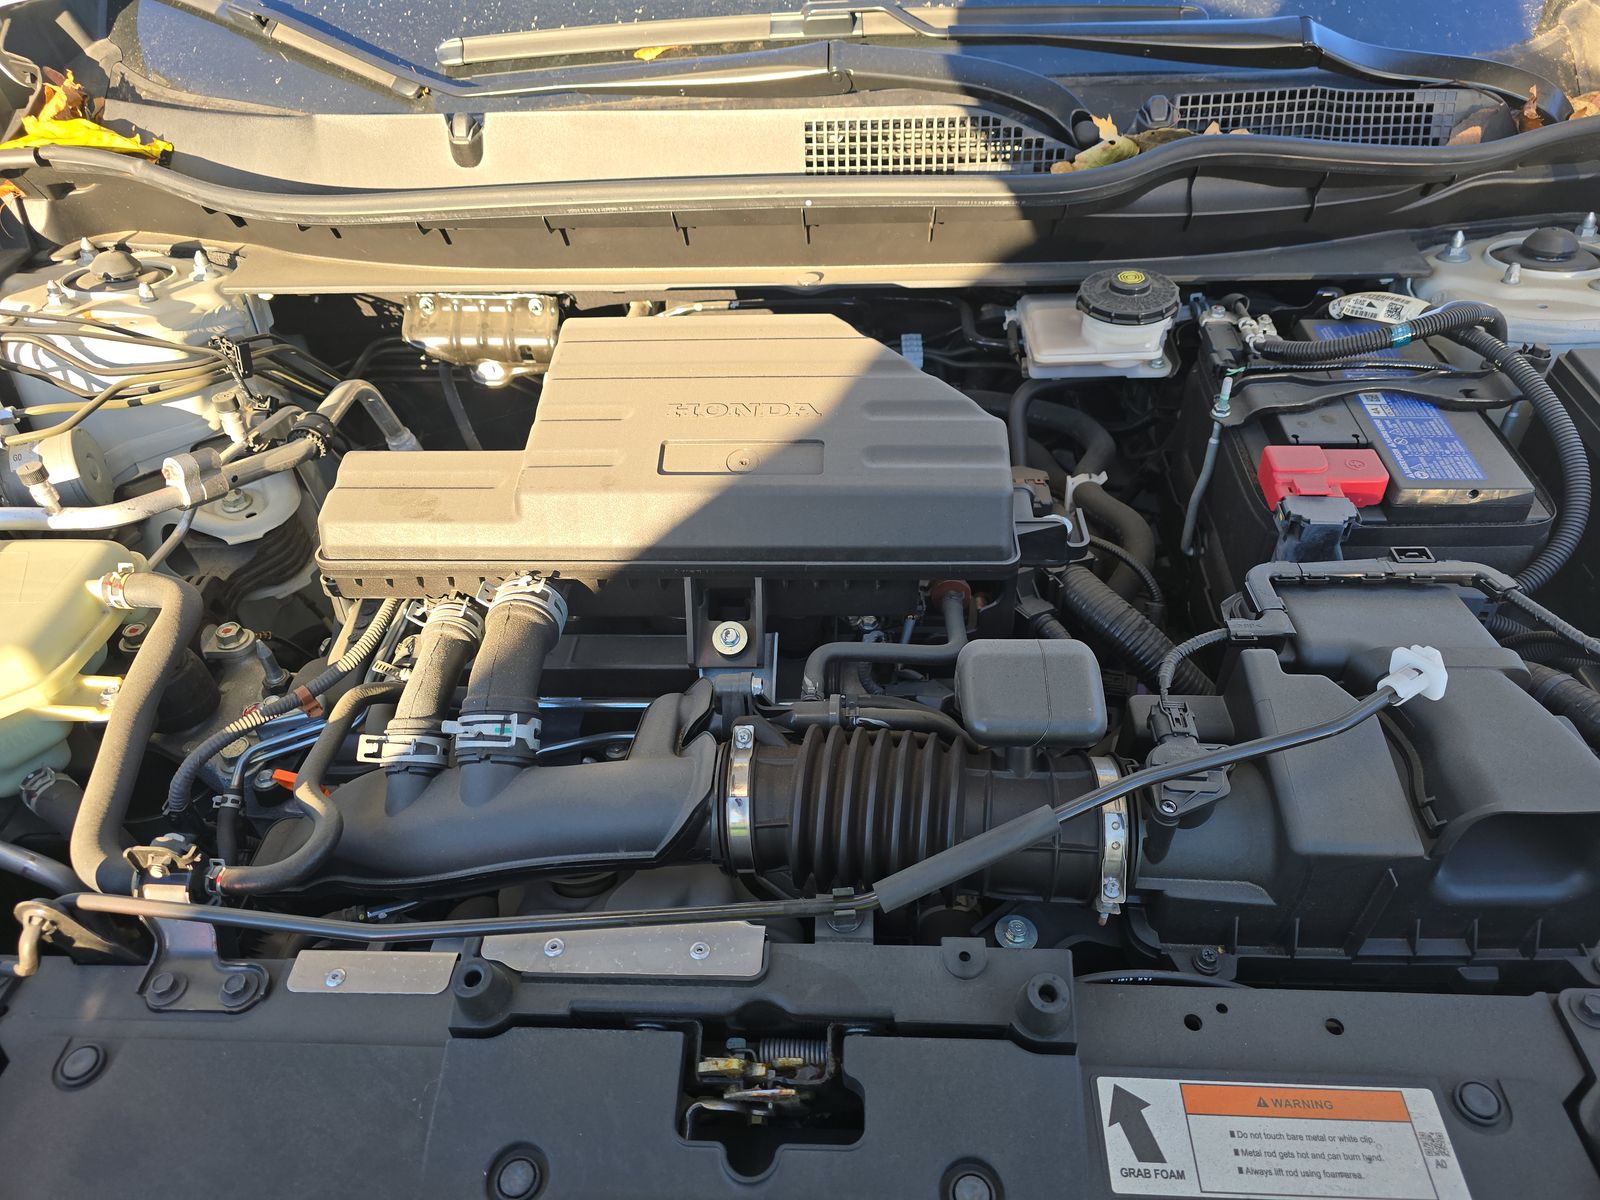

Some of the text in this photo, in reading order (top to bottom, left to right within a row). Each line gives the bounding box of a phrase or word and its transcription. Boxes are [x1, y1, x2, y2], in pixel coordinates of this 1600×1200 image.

[666, 402, 823, 418] HONDA
[1271, 1098, 1334, 1110] WARNING
[1236, 1130, 1248, 1139] Do
[1263, 1132, 1285, 1140] touch
[1286, 1133, 1304, 1141] bare
[1305, 1134, 1326, 1142] metal
[1338, 1133, 1358, 1143] white
[1360, 1135, 1376, 1145] clip.
[1240, 1148, 1262, 1157] Metal
[1264, 1150, 1277, 1158] rod
[1278, 1151, 1295, 1159] gets
[1296, 1151, 1310, 1159] hot
[1311, 1152, 1326, 1160] and
[1327, 1153, 1341, 1161] can
[1343, 1152, 1360, 1161] burn
[1120, 1167, 1186, 1180] GRAB FOAM
[1245, 1167, 1273, 1178] Always
[1274, 1168, 1284, 1177] lift
[1285, 1169, 1299, 1177] rod
[1300, 1169, 1322, 1179] using
